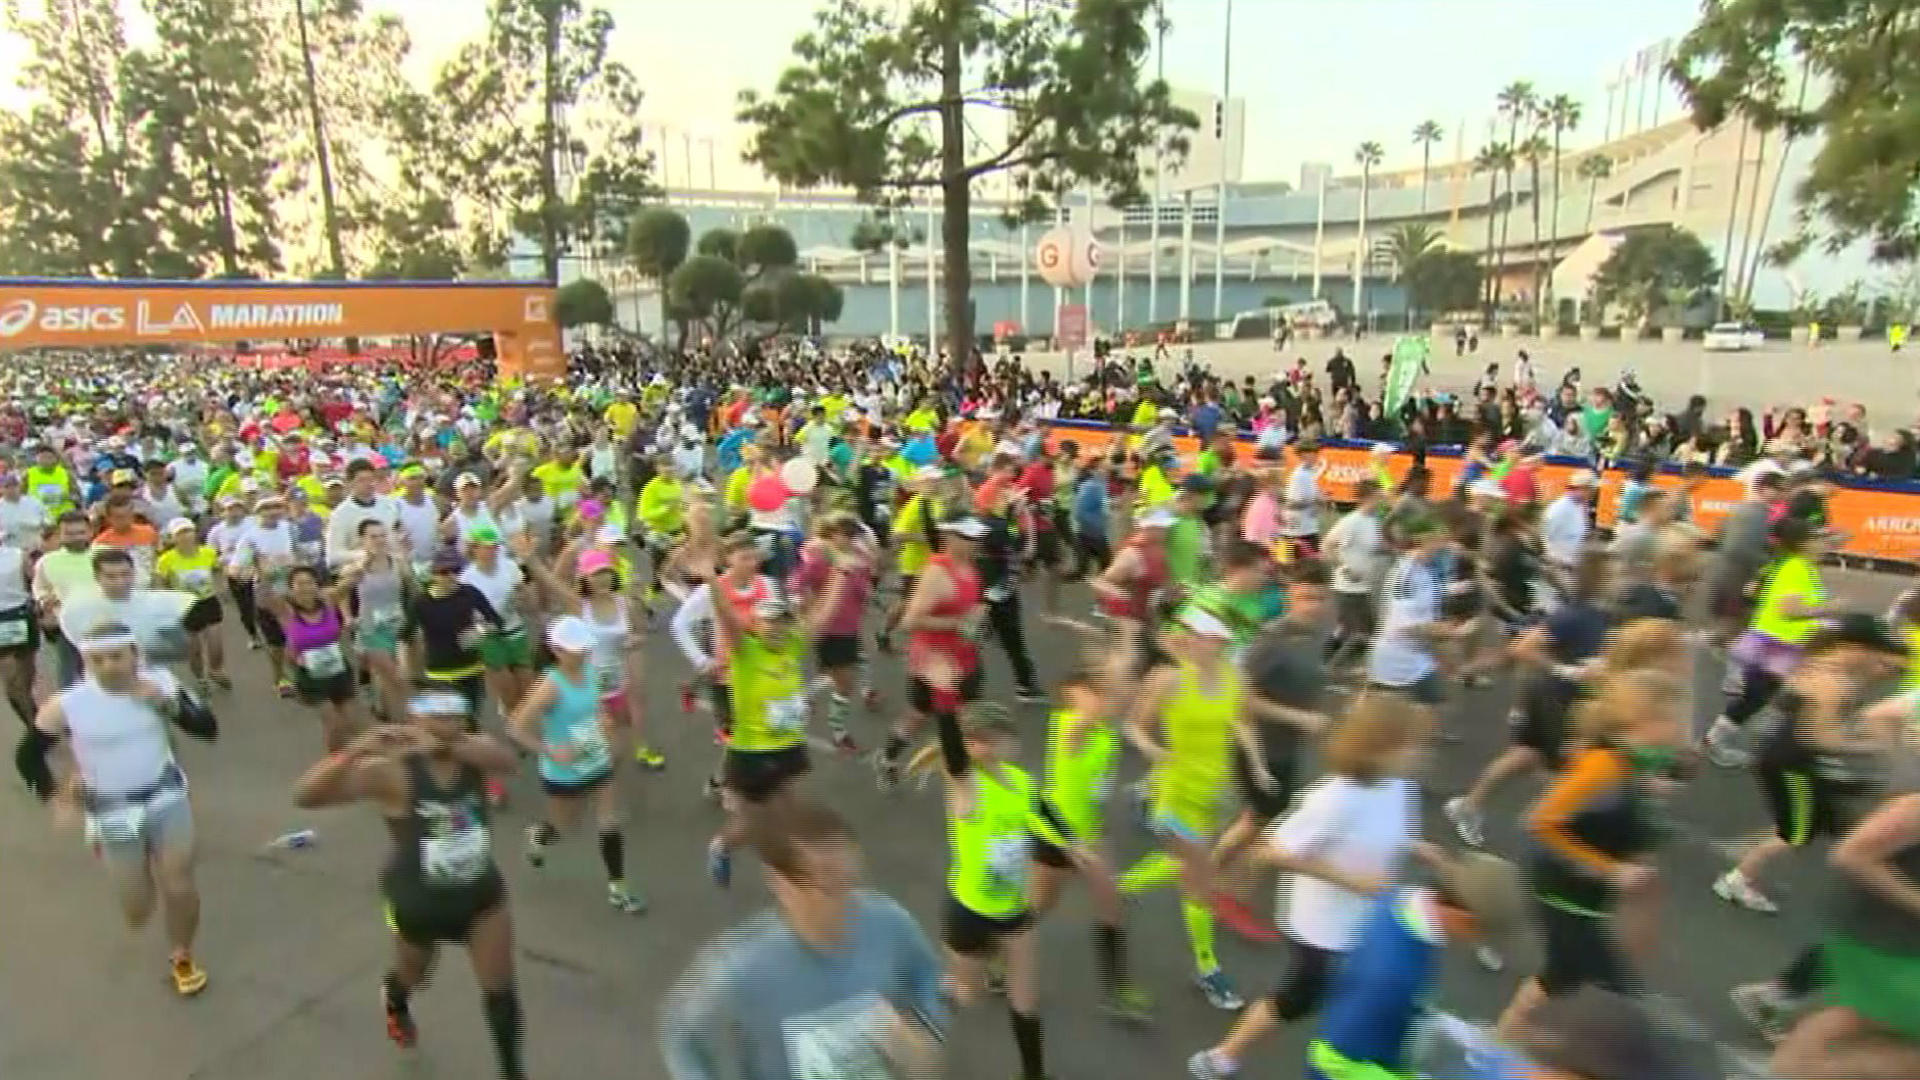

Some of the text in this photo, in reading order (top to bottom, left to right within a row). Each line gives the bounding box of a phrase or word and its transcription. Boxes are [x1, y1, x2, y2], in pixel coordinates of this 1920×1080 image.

[1041, 244, 1059, 268] G
[40, 300, 343, 335] asics LA MARATHON
